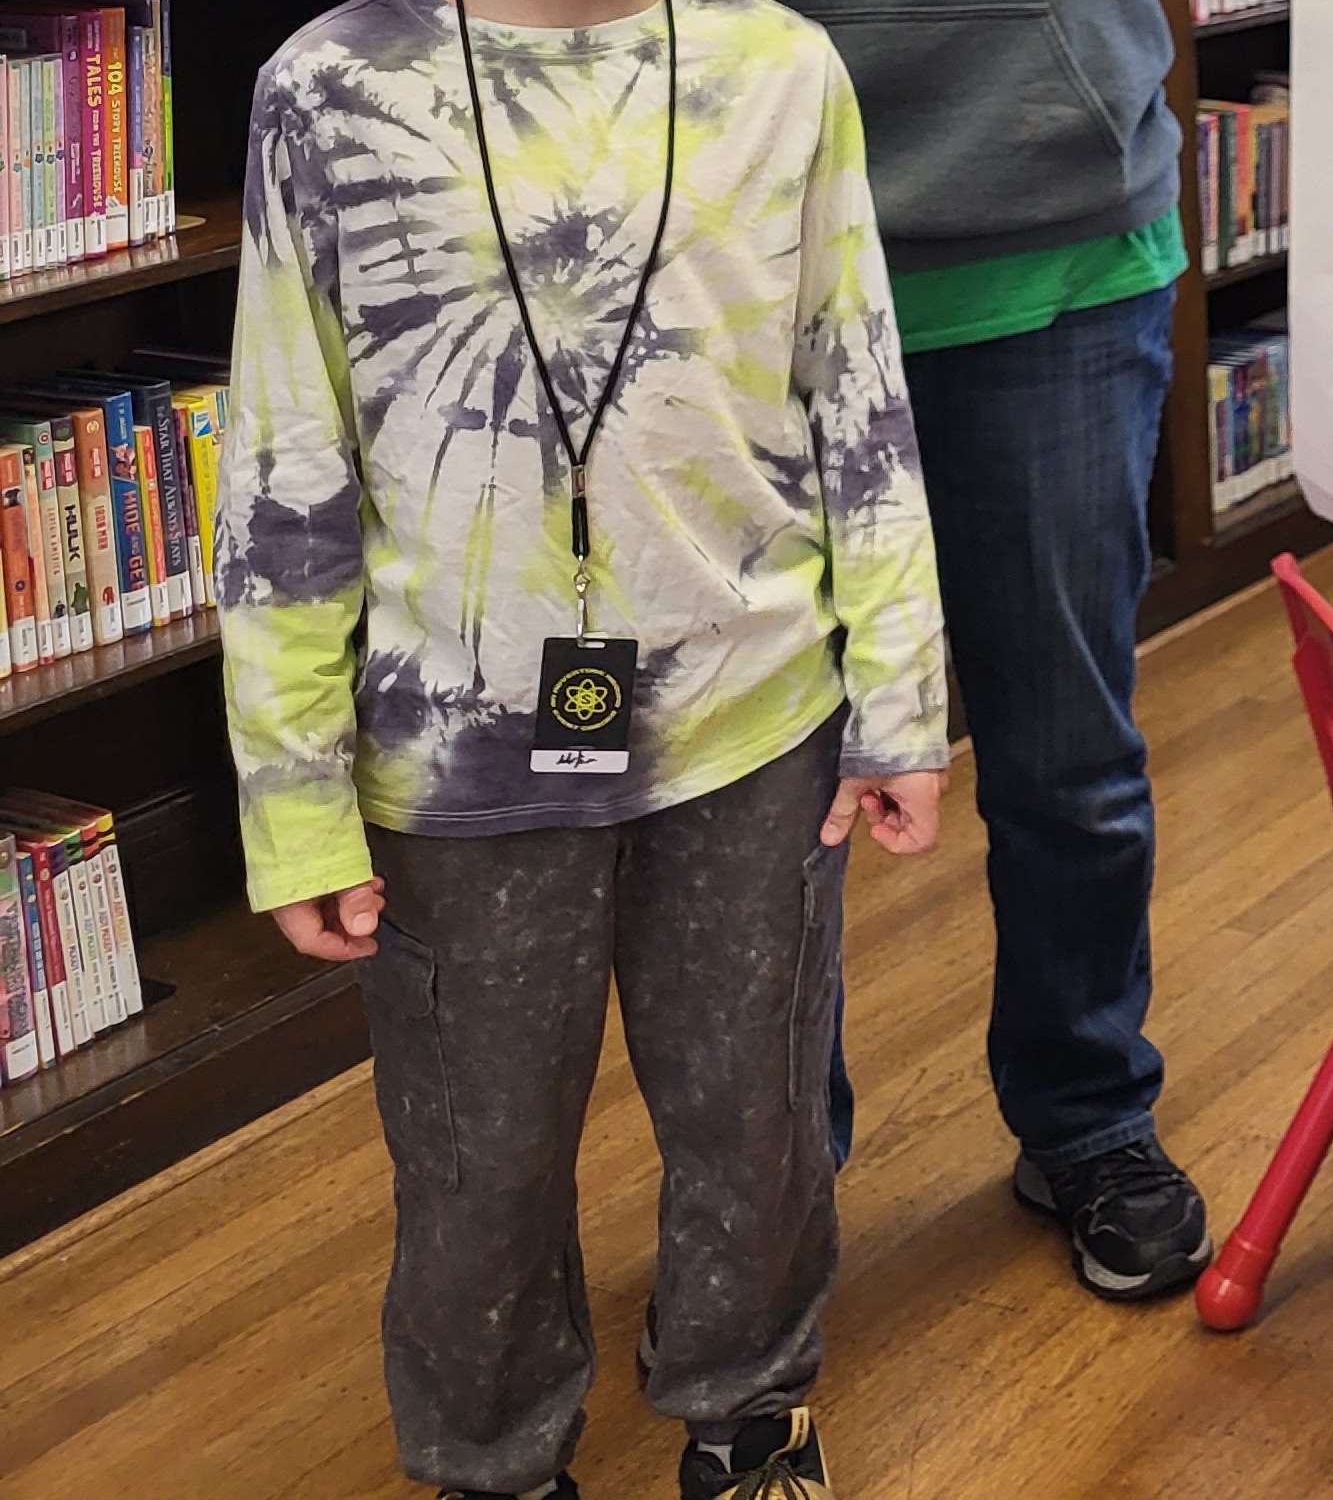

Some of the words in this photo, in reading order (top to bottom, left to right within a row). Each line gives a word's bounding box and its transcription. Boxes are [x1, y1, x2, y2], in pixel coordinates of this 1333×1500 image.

[86, 54, 102, 107] TALES
[107, 62, 123, 95] 104
[111, 100, 120, 133] STORY
[112, 137, 122, 192] TREEHOUSE
[158, 418, 171, 449] STAR
[161, 450, 174, 480] THAT
[122, 490, 140, 533] HIDE
[165, 485, 179, 531] ALWAYS
[65, 504, 80, 562] HULK
[170, 532, 183, 566] STAYS
[581, 694, 591, 705] S
